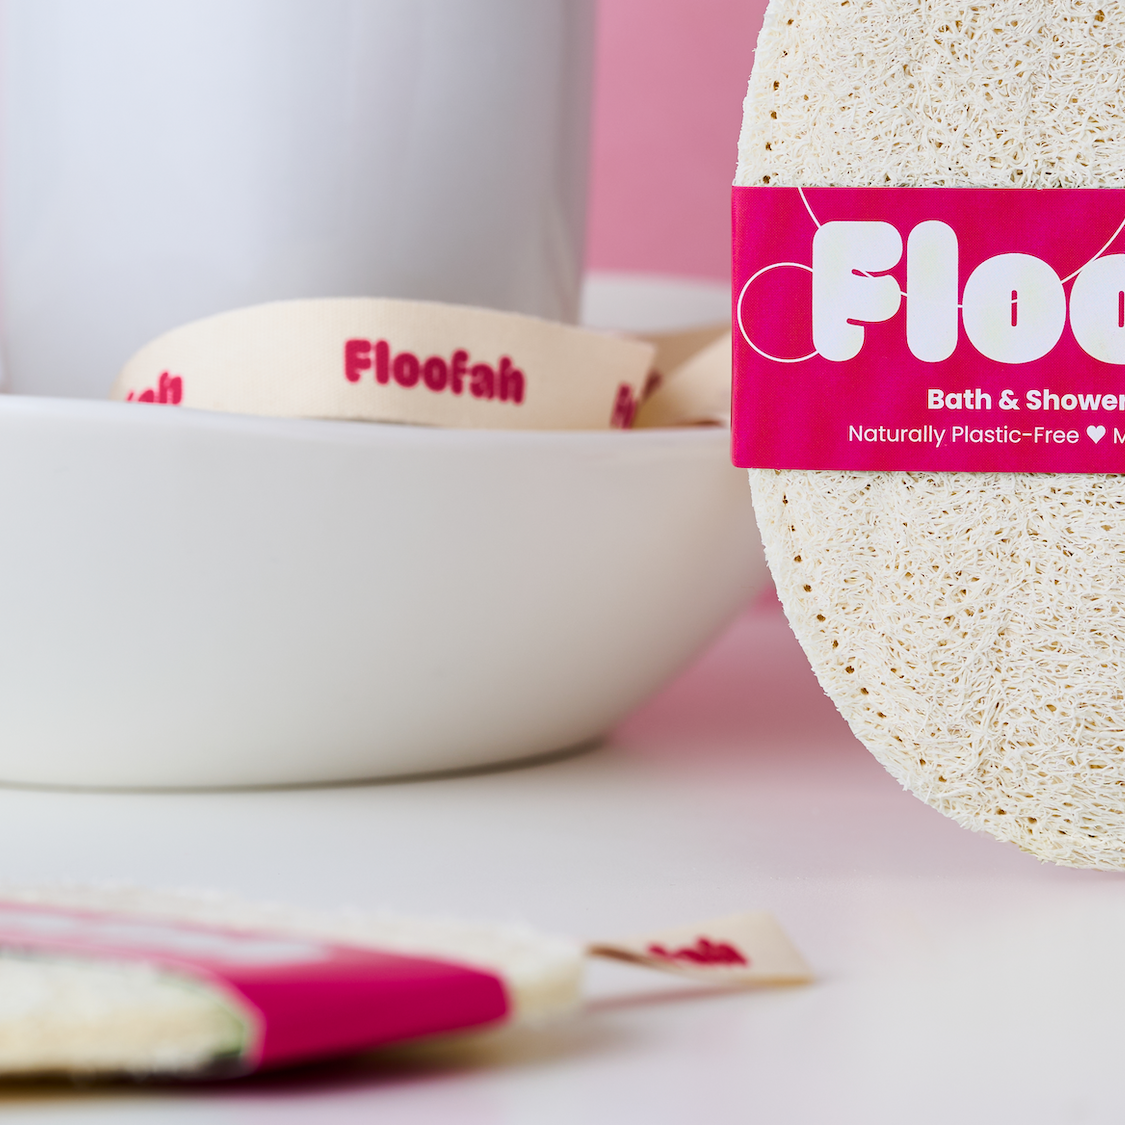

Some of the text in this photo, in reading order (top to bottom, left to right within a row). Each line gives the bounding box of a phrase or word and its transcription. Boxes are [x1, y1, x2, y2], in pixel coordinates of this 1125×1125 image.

[343, 338, 526, 405] Floofah
[927, 388, 992, 411] Bath
[999, 388, 1021, 411] &
[848, 424, 946, 448] Naturally
[952, 424, 1080, 445] Plastic-Free
